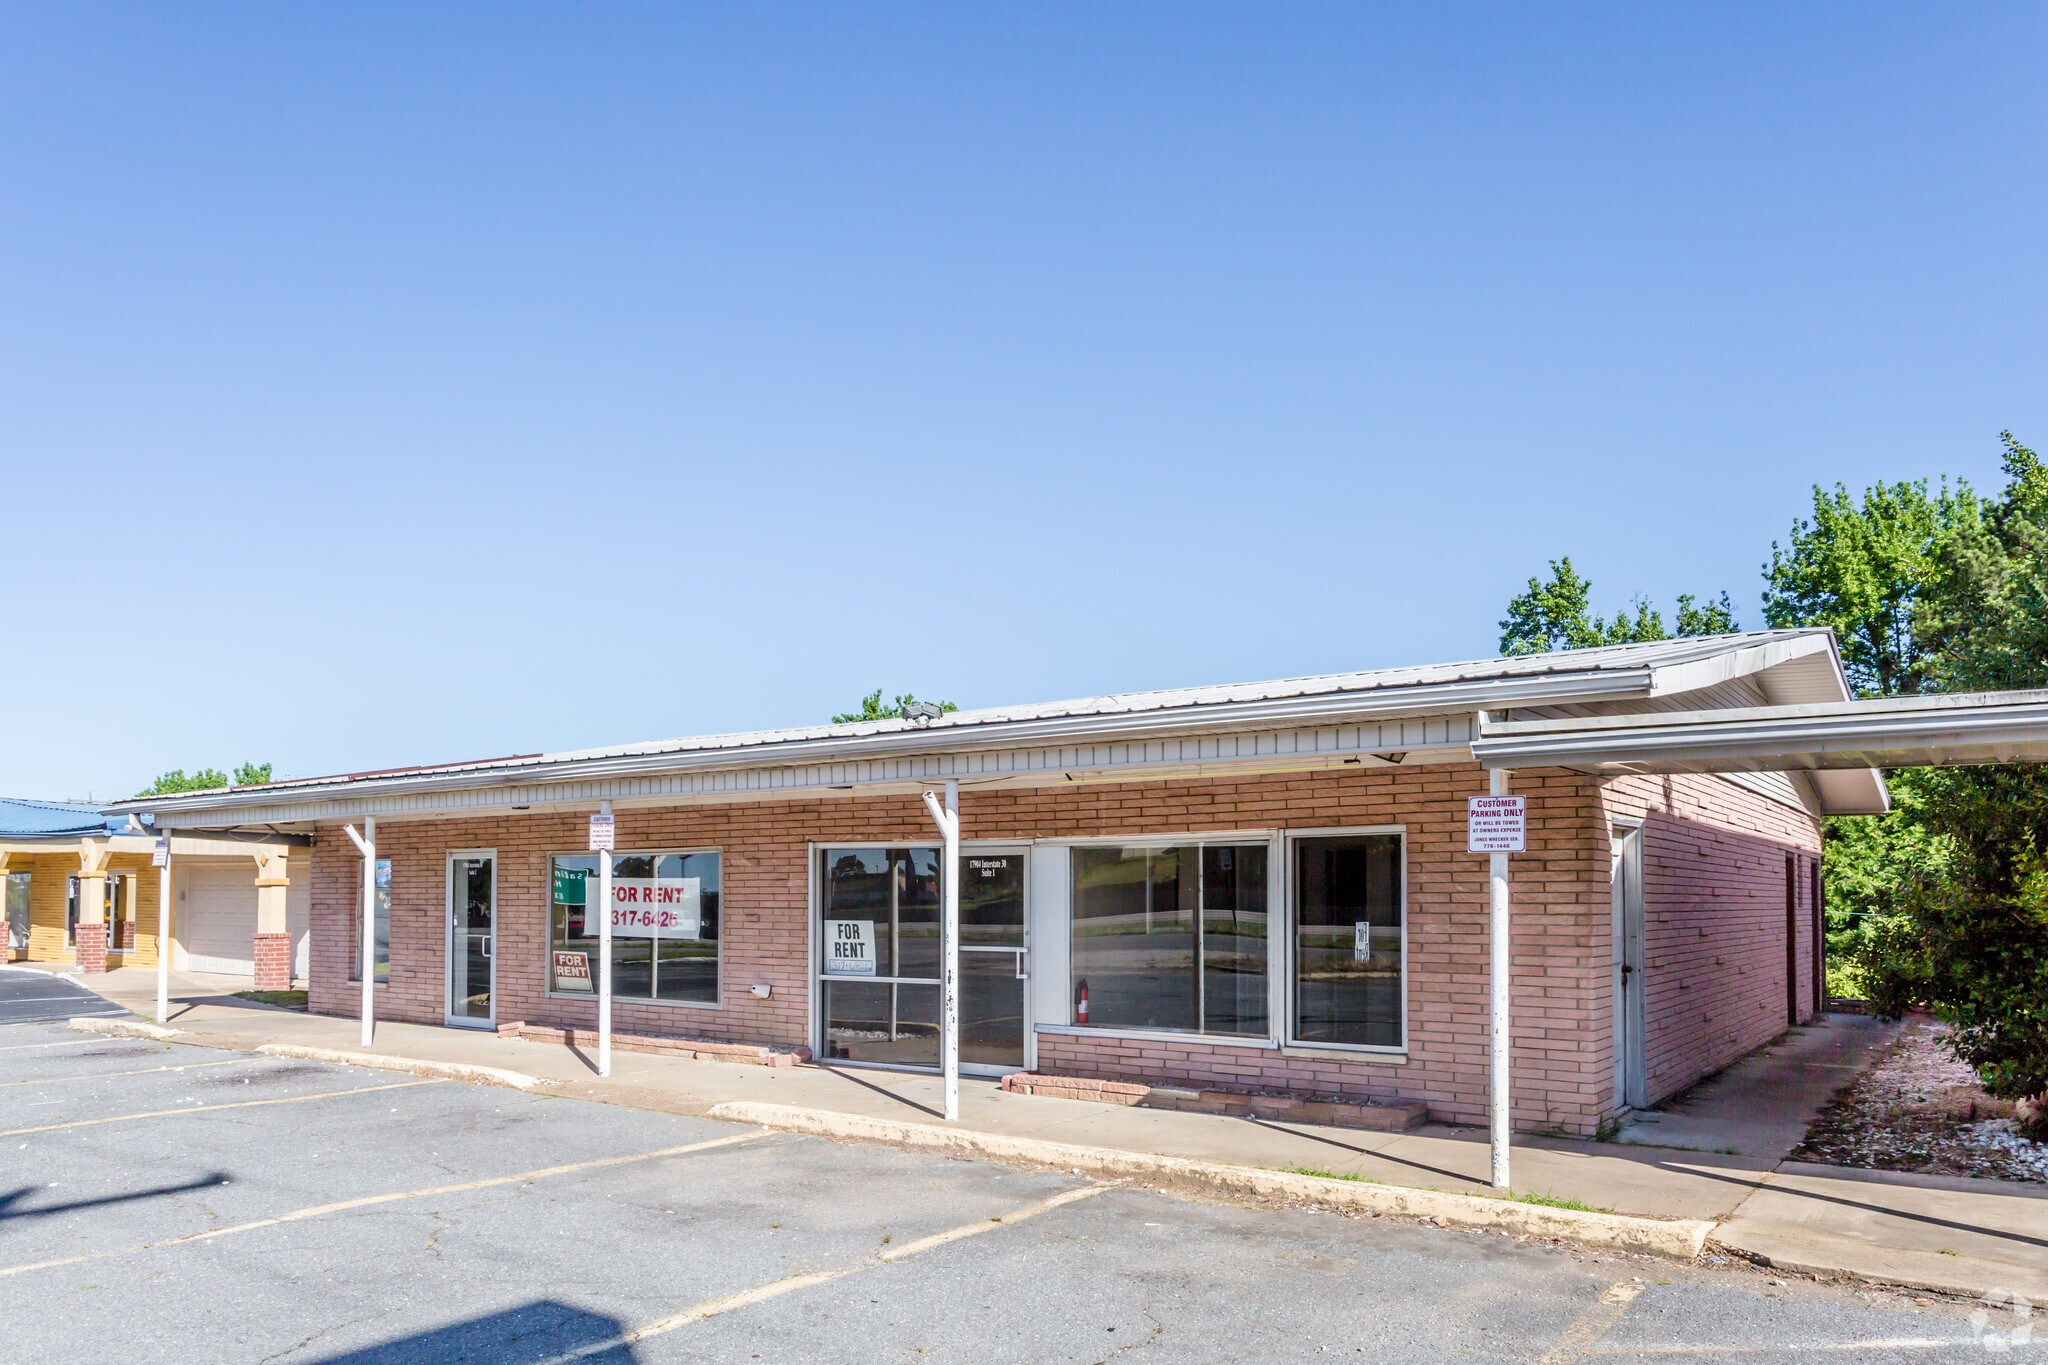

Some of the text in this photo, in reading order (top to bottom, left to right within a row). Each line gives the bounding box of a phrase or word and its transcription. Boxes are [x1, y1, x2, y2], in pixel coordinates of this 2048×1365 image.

[643, 887, 684, 903] RENT
[612, 910, 678, 927] 317-6426
[838, 923, 860, 939] FOR
[834, 942, 865, 958] RENT
[559, 955, 582, 966] FOR
[556, 965, 586, 977] RENT
